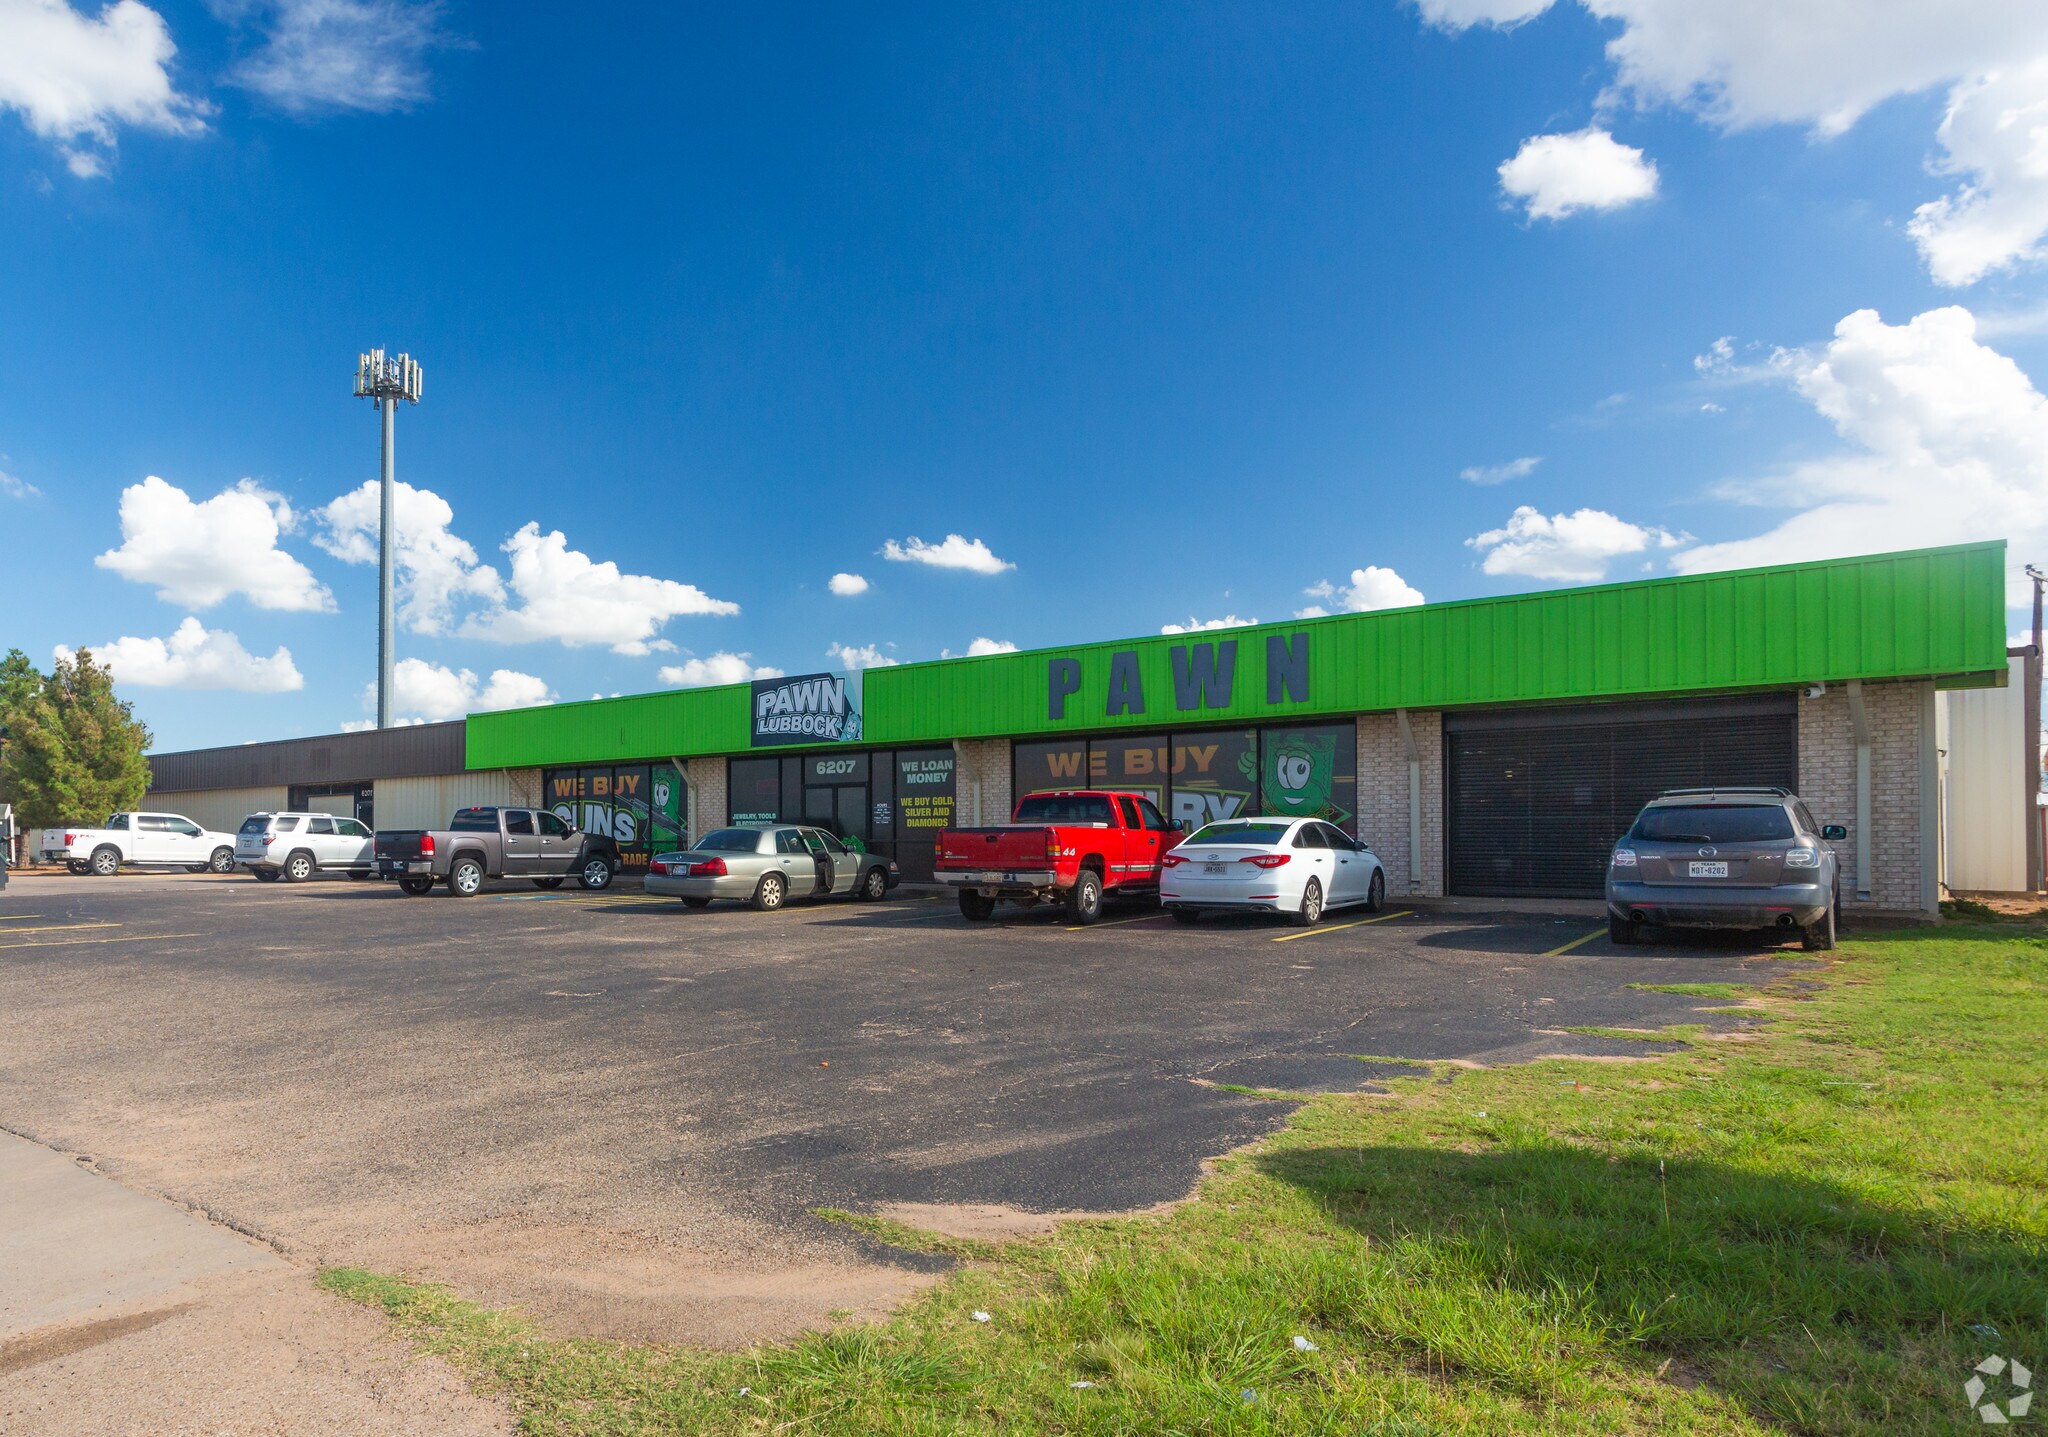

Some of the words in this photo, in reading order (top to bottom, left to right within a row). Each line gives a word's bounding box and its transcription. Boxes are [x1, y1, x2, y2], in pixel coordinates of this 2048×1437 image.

[1049, 632, 1310, 720] PAWN
[757, 678, 845, 718] PAWN
[757, 714, 841, 739] LUBBOCK
[816, 760, 856, 775] 6207
[901, 761, 919, 772] WE
[921, 760, 953, 771] LOAN
[1047, 751, 1108, 778] WE
[1124, 745, 1220, 776] BUY
[907, 772, 949, 784] MONEY
[553, 777, 586, 797] WE
[593, 775, 641, 796] BUY
[900, 797, 913, 807] WE
[914, 797, 930, 806] BUY
[932, 796, 955, 807] GOLD,
[758, 812, 777, 820] TOOLS
[905, 808, 932, 817] SILVER
[933, 807, 950, 817] AND
[907, 818, 949, 827] DIAMONDS
